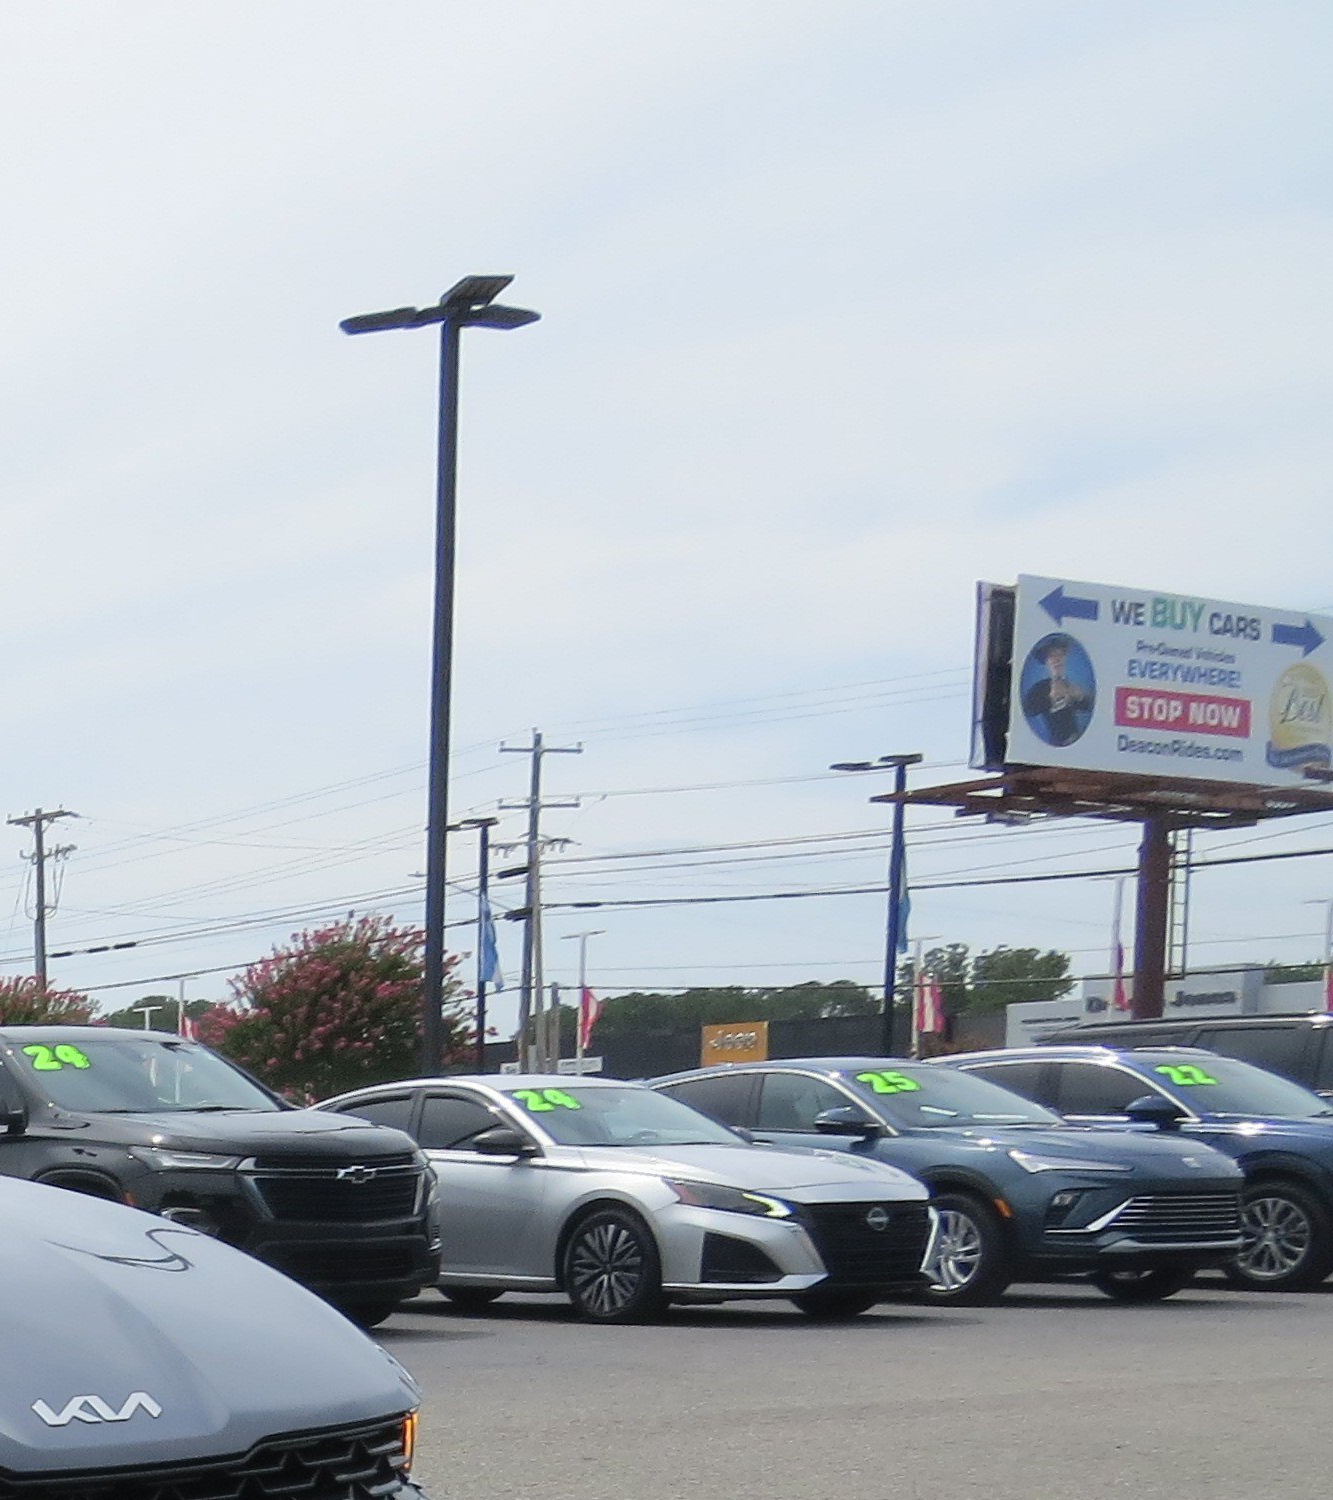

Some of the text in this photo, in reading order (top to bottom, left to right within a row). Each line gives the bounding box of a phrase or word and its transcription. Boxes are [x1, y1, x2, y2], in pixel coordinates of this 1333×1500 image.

[1111, 597, 1262, 642] WE BUY CARS
[1127, 659, 1242, 689] EVERYWHERE!
[1125, 695, 1242, 729] STOP NOW
[1117, 733, 1244, 762] DeaconRides.com
[21, 1043, 92, 1071] 24
[855, 1070, 921, 1095] 25
[1154, 1064, 1218, 1087] 22
[511, 1088, 582, 1113] 24
[31, 1390, 163, 1427] KIA
